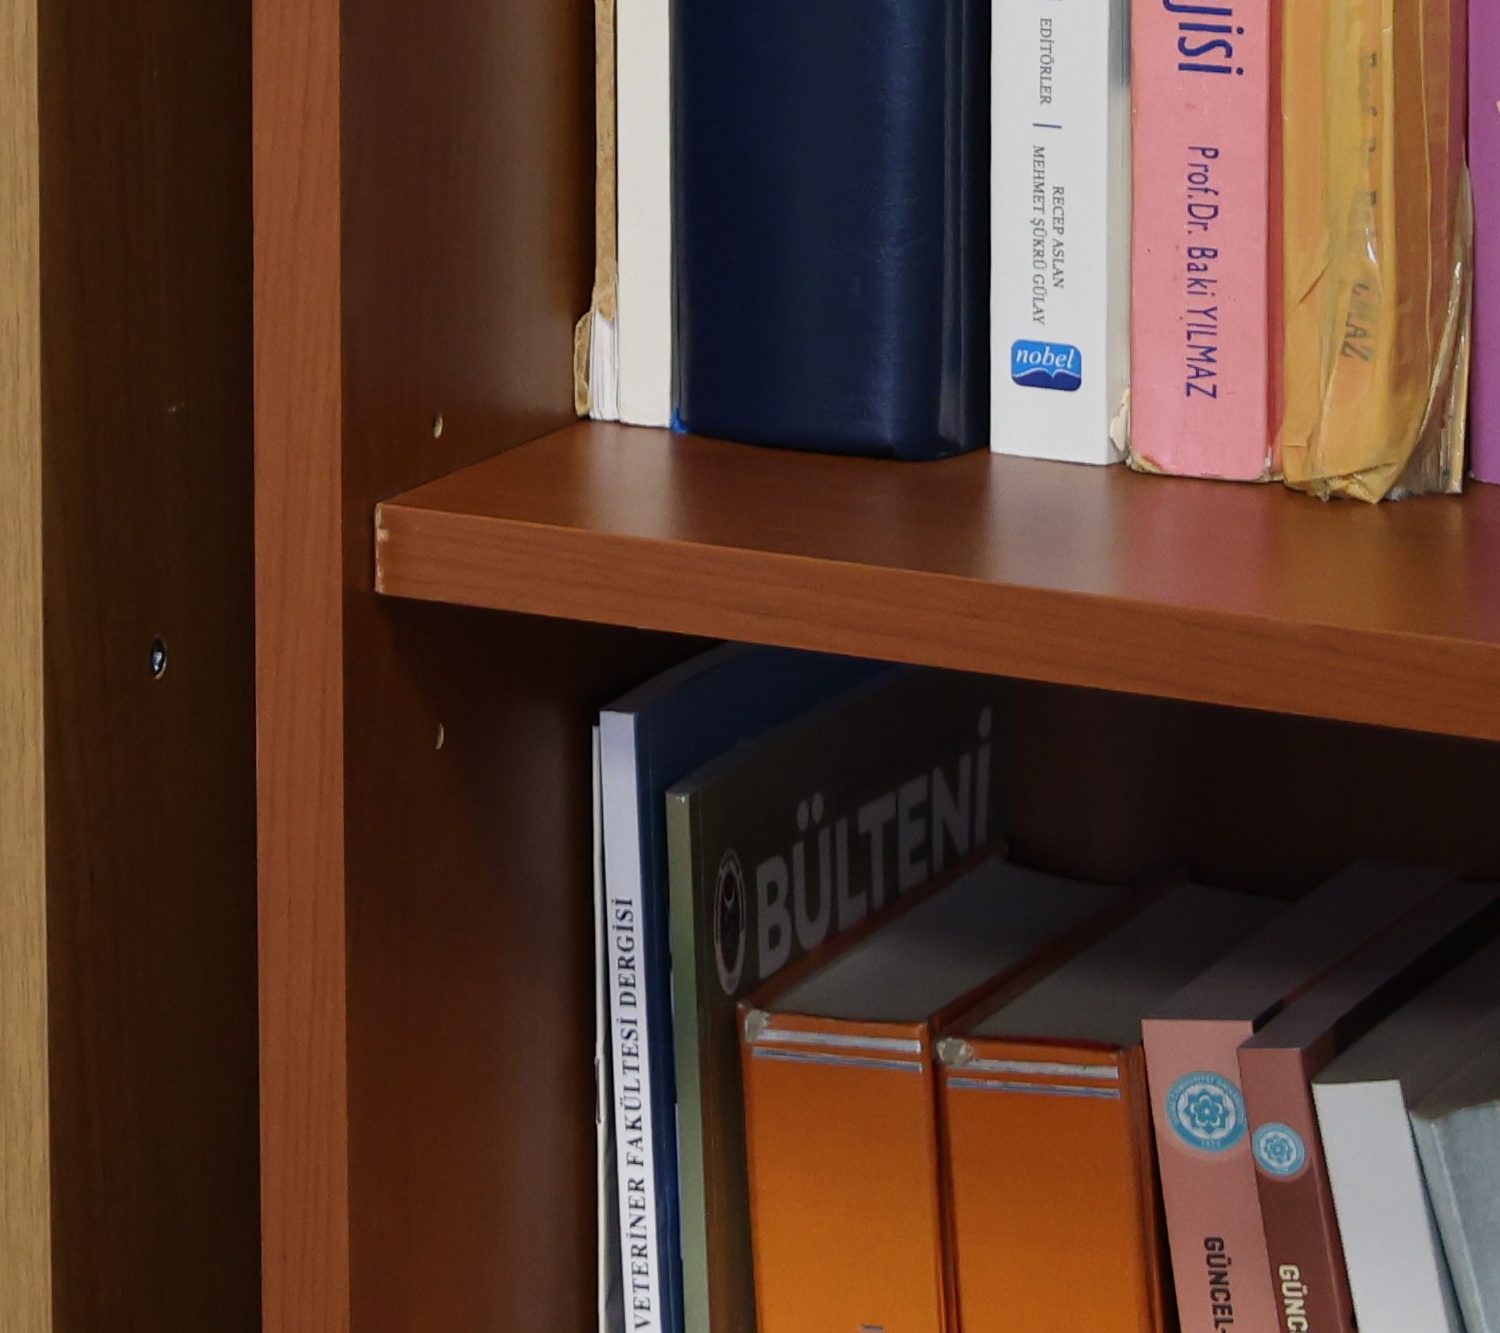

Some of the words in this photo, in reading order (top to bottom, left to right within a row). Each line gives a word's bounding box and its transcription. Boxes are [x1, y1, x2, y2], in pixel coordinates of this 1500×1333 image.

[1038, 16, 1055, 107] EDİTÖRLER
[1032, 144, 1047, 215] MEHMET
[1051, 184, 1066, 236] RECEP
[1029, 216, 1048, 272] ŞÜKRÜ
[1051, 236, 1065, 290] ASLAN
[1186, 245, 1219, 297] Baki
[1032, 273, 1047, 326] GÜLAY
[1014, 343, 1076, 370] nobel
[1185, 305, 1219, 400] YILMAZ
[755, 705, 993, 980] BÜLTENİ
[610, 896, 638, 1010] DERGİSİ
[618, 1015, 645, 1169] FAKÜLTESİ
[624, 1176, 652, 1331] VETERİNER
[1278, 1263, 1309, 1333] GÜNC
